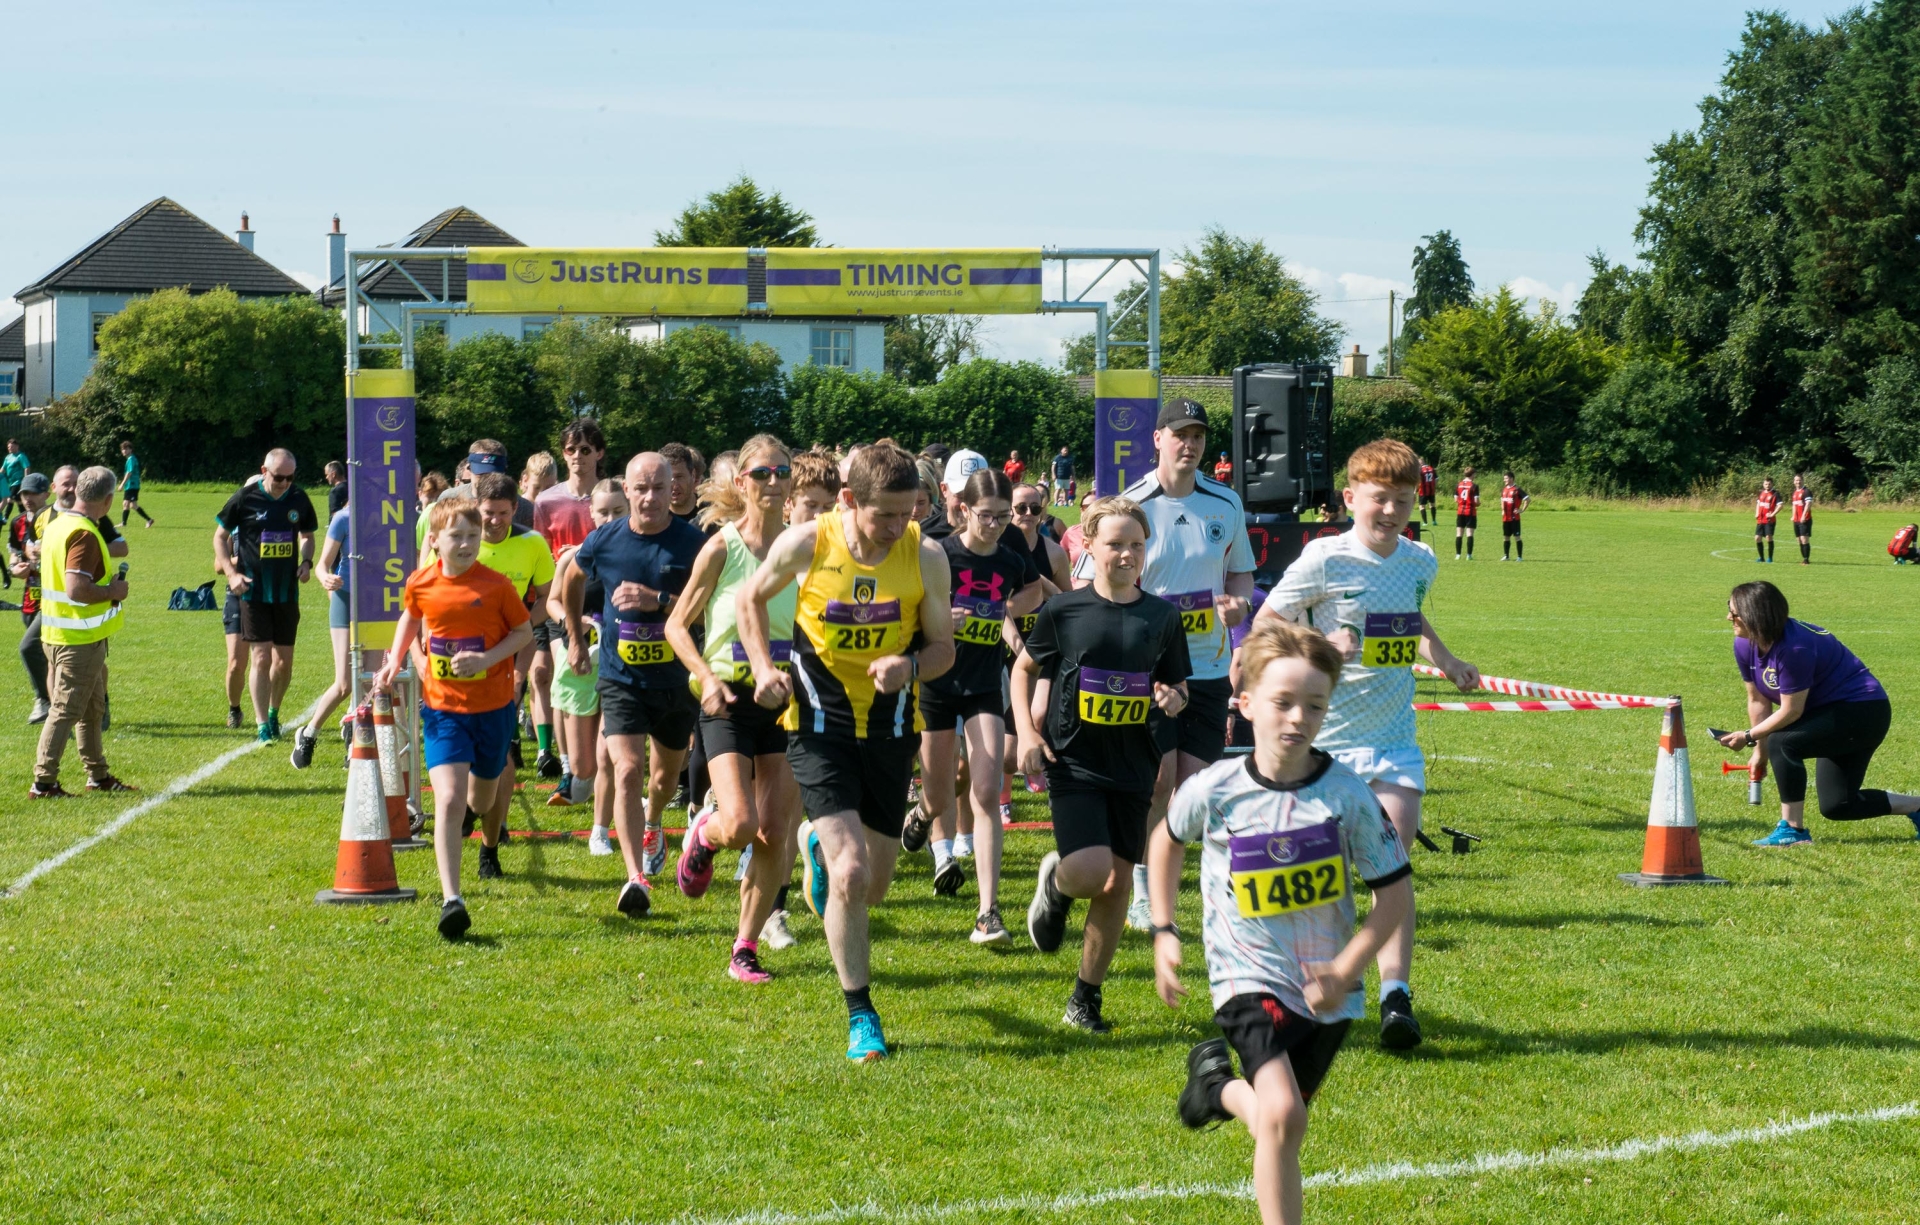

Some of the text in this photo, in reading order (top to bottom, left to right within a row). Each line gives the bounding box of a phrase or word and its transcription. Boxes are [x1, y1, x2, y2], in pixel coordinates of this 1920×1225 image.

[550, 260, 702, 285] JustRuns
[847, 263, 963, 286] TIMING
[846, 287, 963, 298] www.justrunsevents.ie
[1461, 489, 1468, 500] 4
[381, 440, 404, 612] FINISH
[263, 544, 292, 556] 2199
[837, 627, 888, 650] 287
[626, 643, 664, 662] 335
[1375, 640, 1416, 665] 333
[1084, 696, 1145, 722] 1470
[1242, 864, 1340, 912] 1482
